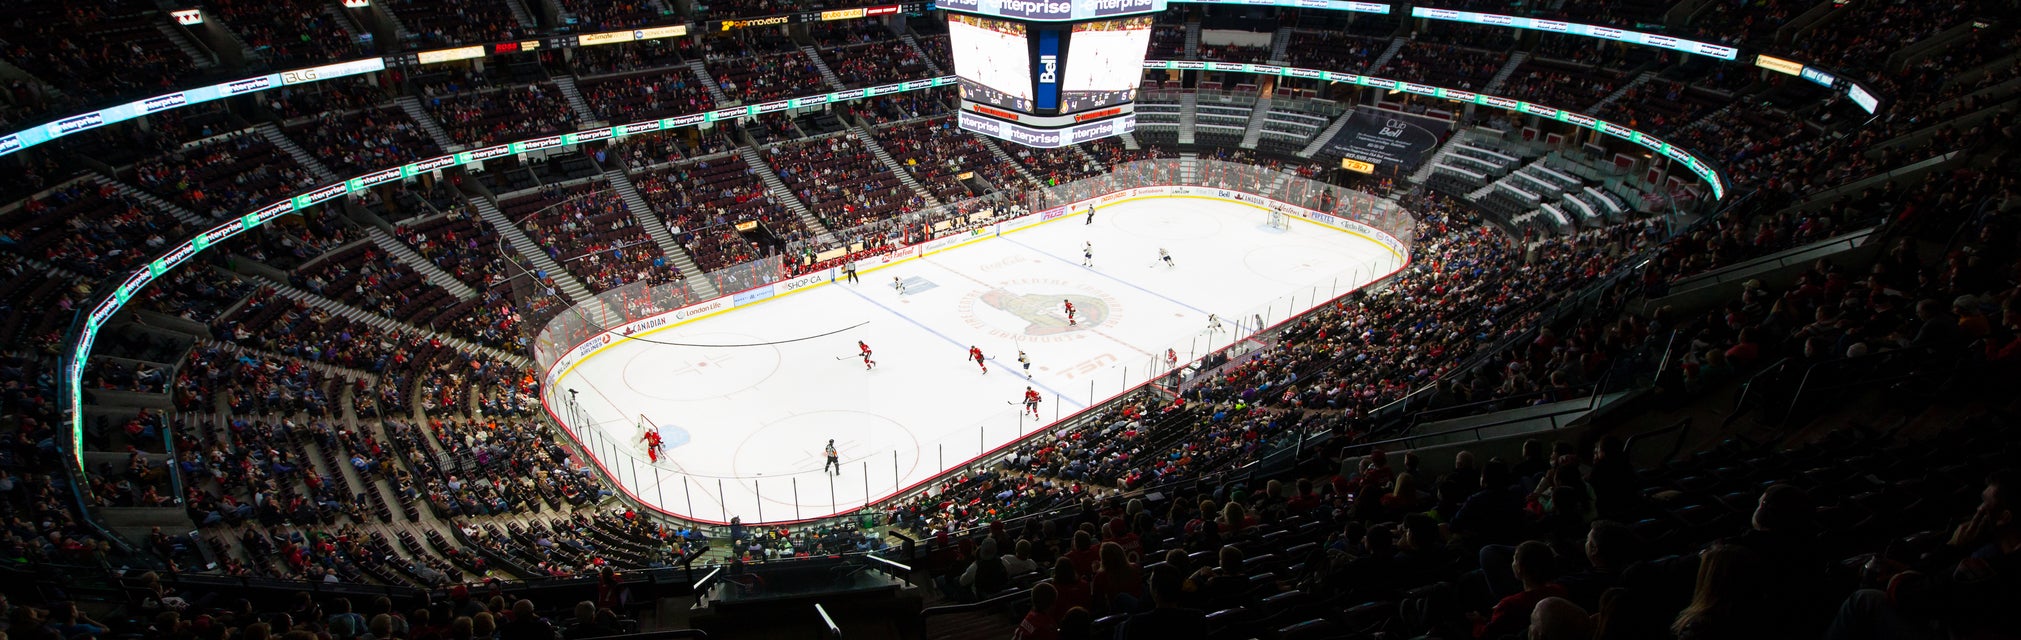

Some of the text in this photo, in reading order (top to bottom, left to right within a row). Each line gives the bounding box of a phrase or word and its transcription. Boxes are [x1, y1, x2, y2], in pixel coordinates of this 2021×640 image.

[285, 69, 317, 83] BLG
[1039, 54, 1057, 83] Bell
[968, 88, 974, 98] 4
[1121, 92, 1128, 100] 5
[1016, 99, 1023, 109] 5
[1071, 100, 1078, 109] 4
[1386, 118, 1407, 129] Club
[1004, 127, 1060, 144] enterprise
[1378, 127, 1403, 138] Bell
[462, 146, 509, 161] enterprise
[407, 157, 454, 174] enterprise
[1347, 161, 1368, 171] TSN
[353, 170, 400, 188] enterprise
[301, 185, 346, 205] enterprise
[1218, 189, 1231, 198] Bell
[249, 201, 292, 222] enterprise
[686, 301, 722, 317] London Life
[633, 317, 667, 333] CANADIAN
[579, 336, 602, 351] TURKISH
[580, 341, 603, 357] AIRLINES
